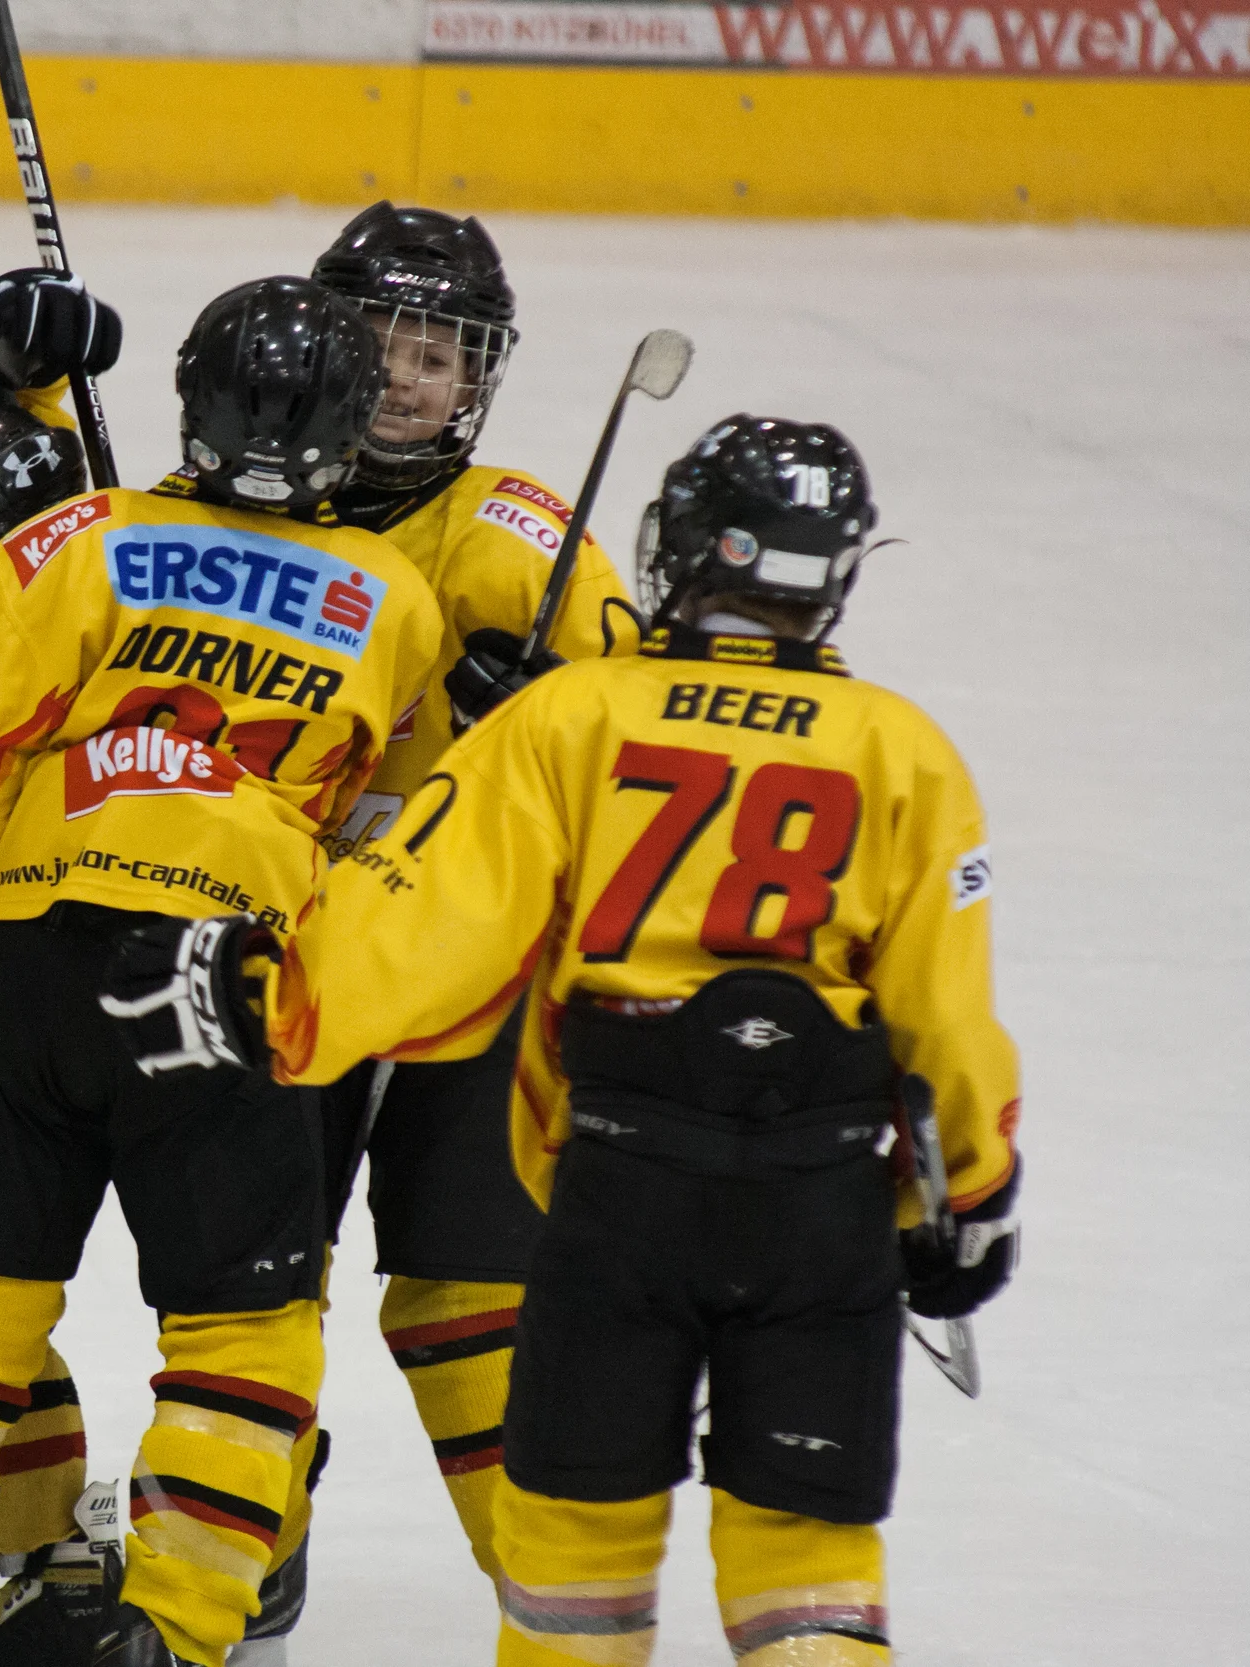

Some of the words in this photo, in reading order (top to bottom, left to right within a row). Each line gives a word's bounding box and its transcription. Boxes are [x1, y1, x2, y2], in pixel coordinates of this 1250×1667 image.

[8, 117, 66, 271] BAUE
[781, 463, 831, 509] 78
[20, 503, 97, 570] Kelly's
[483, 501, 561, 550] RICO
[114, 541, 319, 630] ERSTE
[313, 621, 362, 652] BANK
[105, 623, 345, 715] DORNER
[660, 681, 822, 738] BEER
[85, 726, 214, 784] Kelly's
[576, 740, 863, 965] 78
